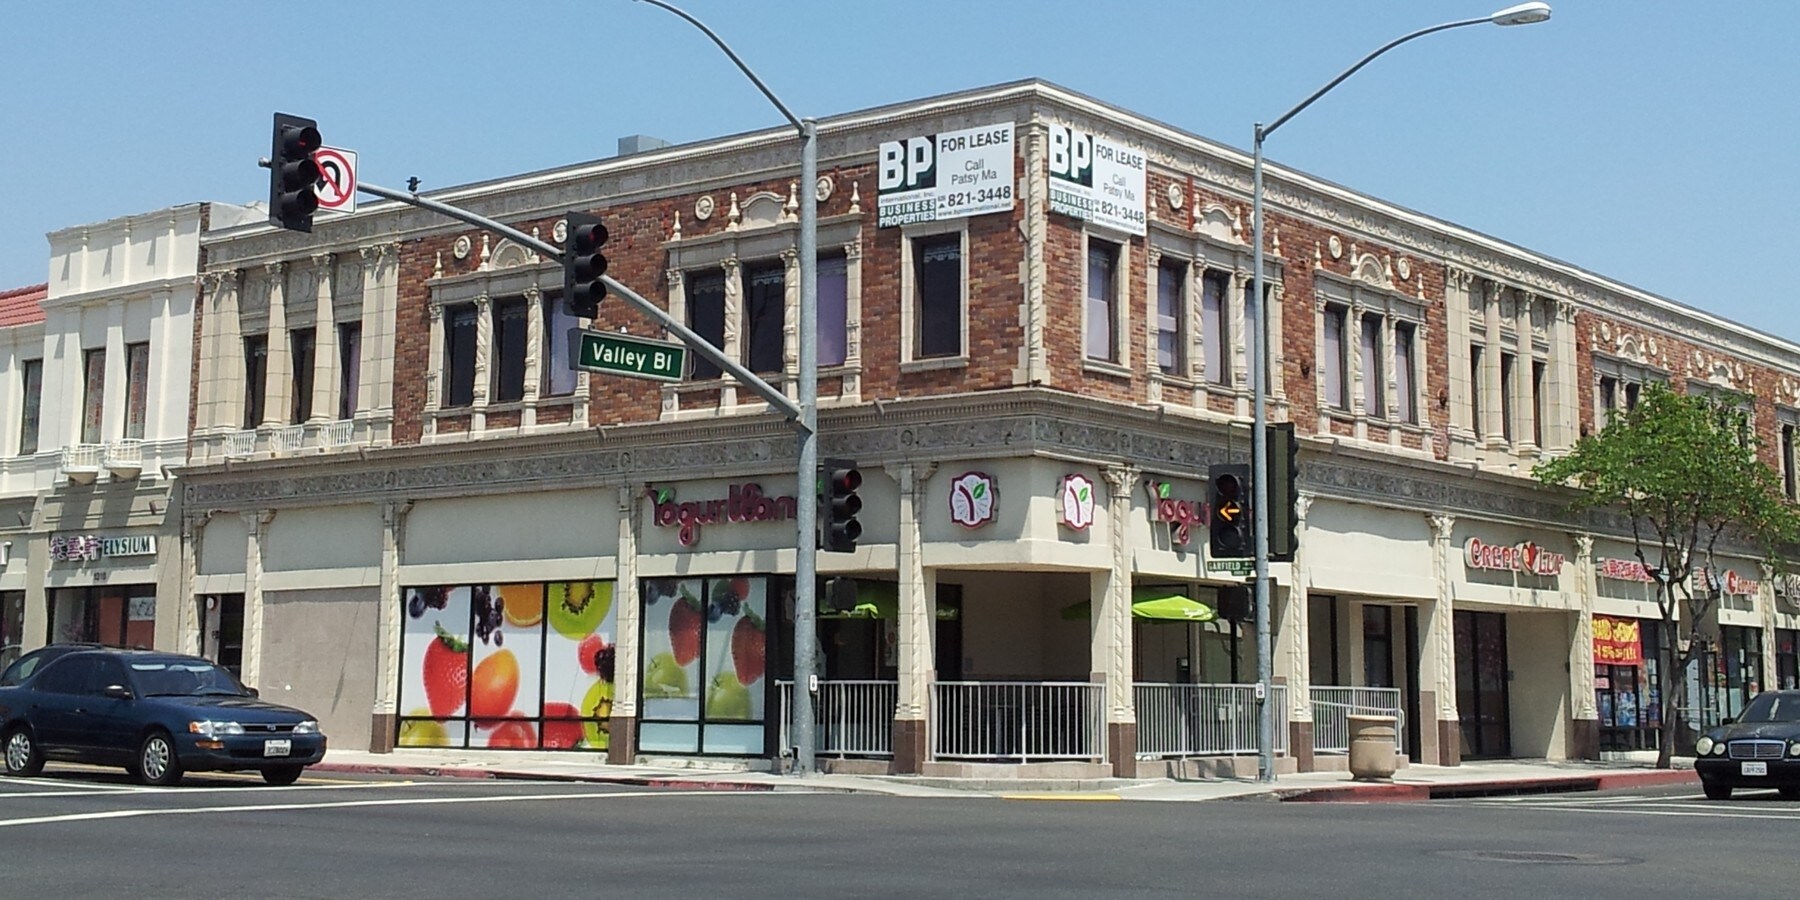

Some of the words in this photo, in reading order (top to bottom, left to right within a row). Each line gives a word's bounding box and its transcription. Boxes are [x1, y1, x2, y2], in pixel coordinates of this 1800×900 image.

[941, 137, 966, 153] FOR
[969, 129, 1009, 149] LEASE
[1049, 123, 1090, 179] BP
[879, 136, 933, 191] BP
[965, 158, 985, 171] Call
[1096, 144, 1114, 161] FOR
[1115, 150, 1143, 170] LEASE
[951, 173, 979, 186] Patsy
[981, 169, 998, 181] Ma
[1113, 173, 1126, 187] Call
[947, 185, 1012, 207] 821-3448
[1050, 189, 1093, 210] BUSINESS
[1103, 182, 1123, 199] Patsy
[880, 199, 935, 216] BUSINESS
[1101, 200, 1145, 224] 821-3448
[879, 210, 935, 229] PROPERTIES
[593, 342, 647, 372] Valley
[646, 483, 798, 547] Yogurtlan
[103, 536, 151, 555] ELYSIUM
[1208, 561, 1241, 570] GARFIELD
